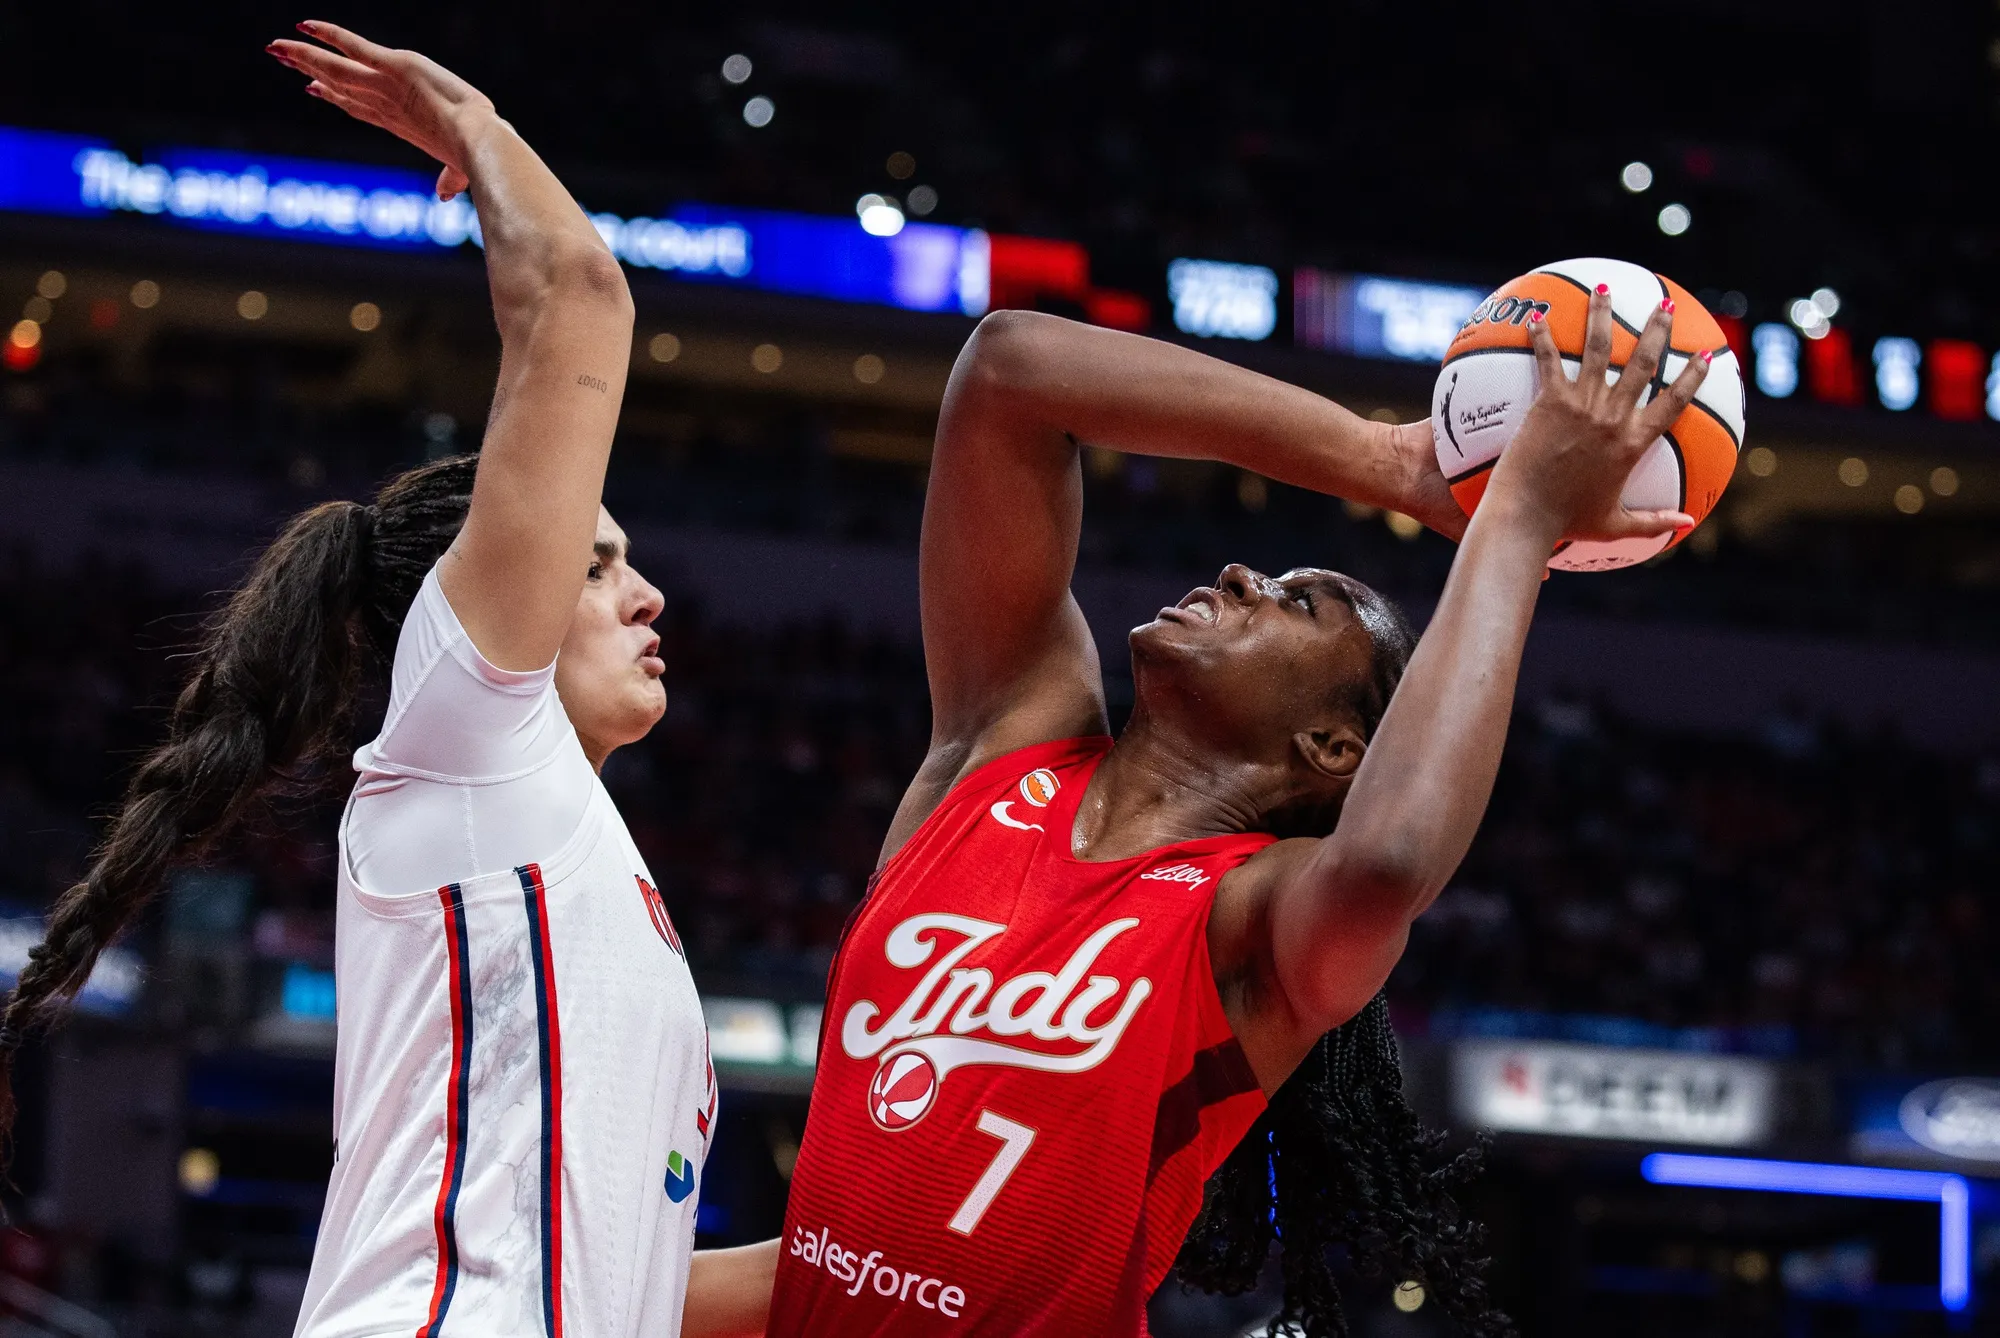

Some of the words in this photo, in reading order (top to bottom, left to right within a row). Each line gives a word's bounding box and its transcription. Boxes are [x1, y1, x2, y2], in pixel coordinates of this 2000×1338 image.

[73, 148, 173, 213] The
[1140, 864, 1211, 891] Lilly
[841, 912, 1152, 1079] Indy
[947, 1108, 1039, 1238] 7
[790, 1225, 966, 1318] salesforce
